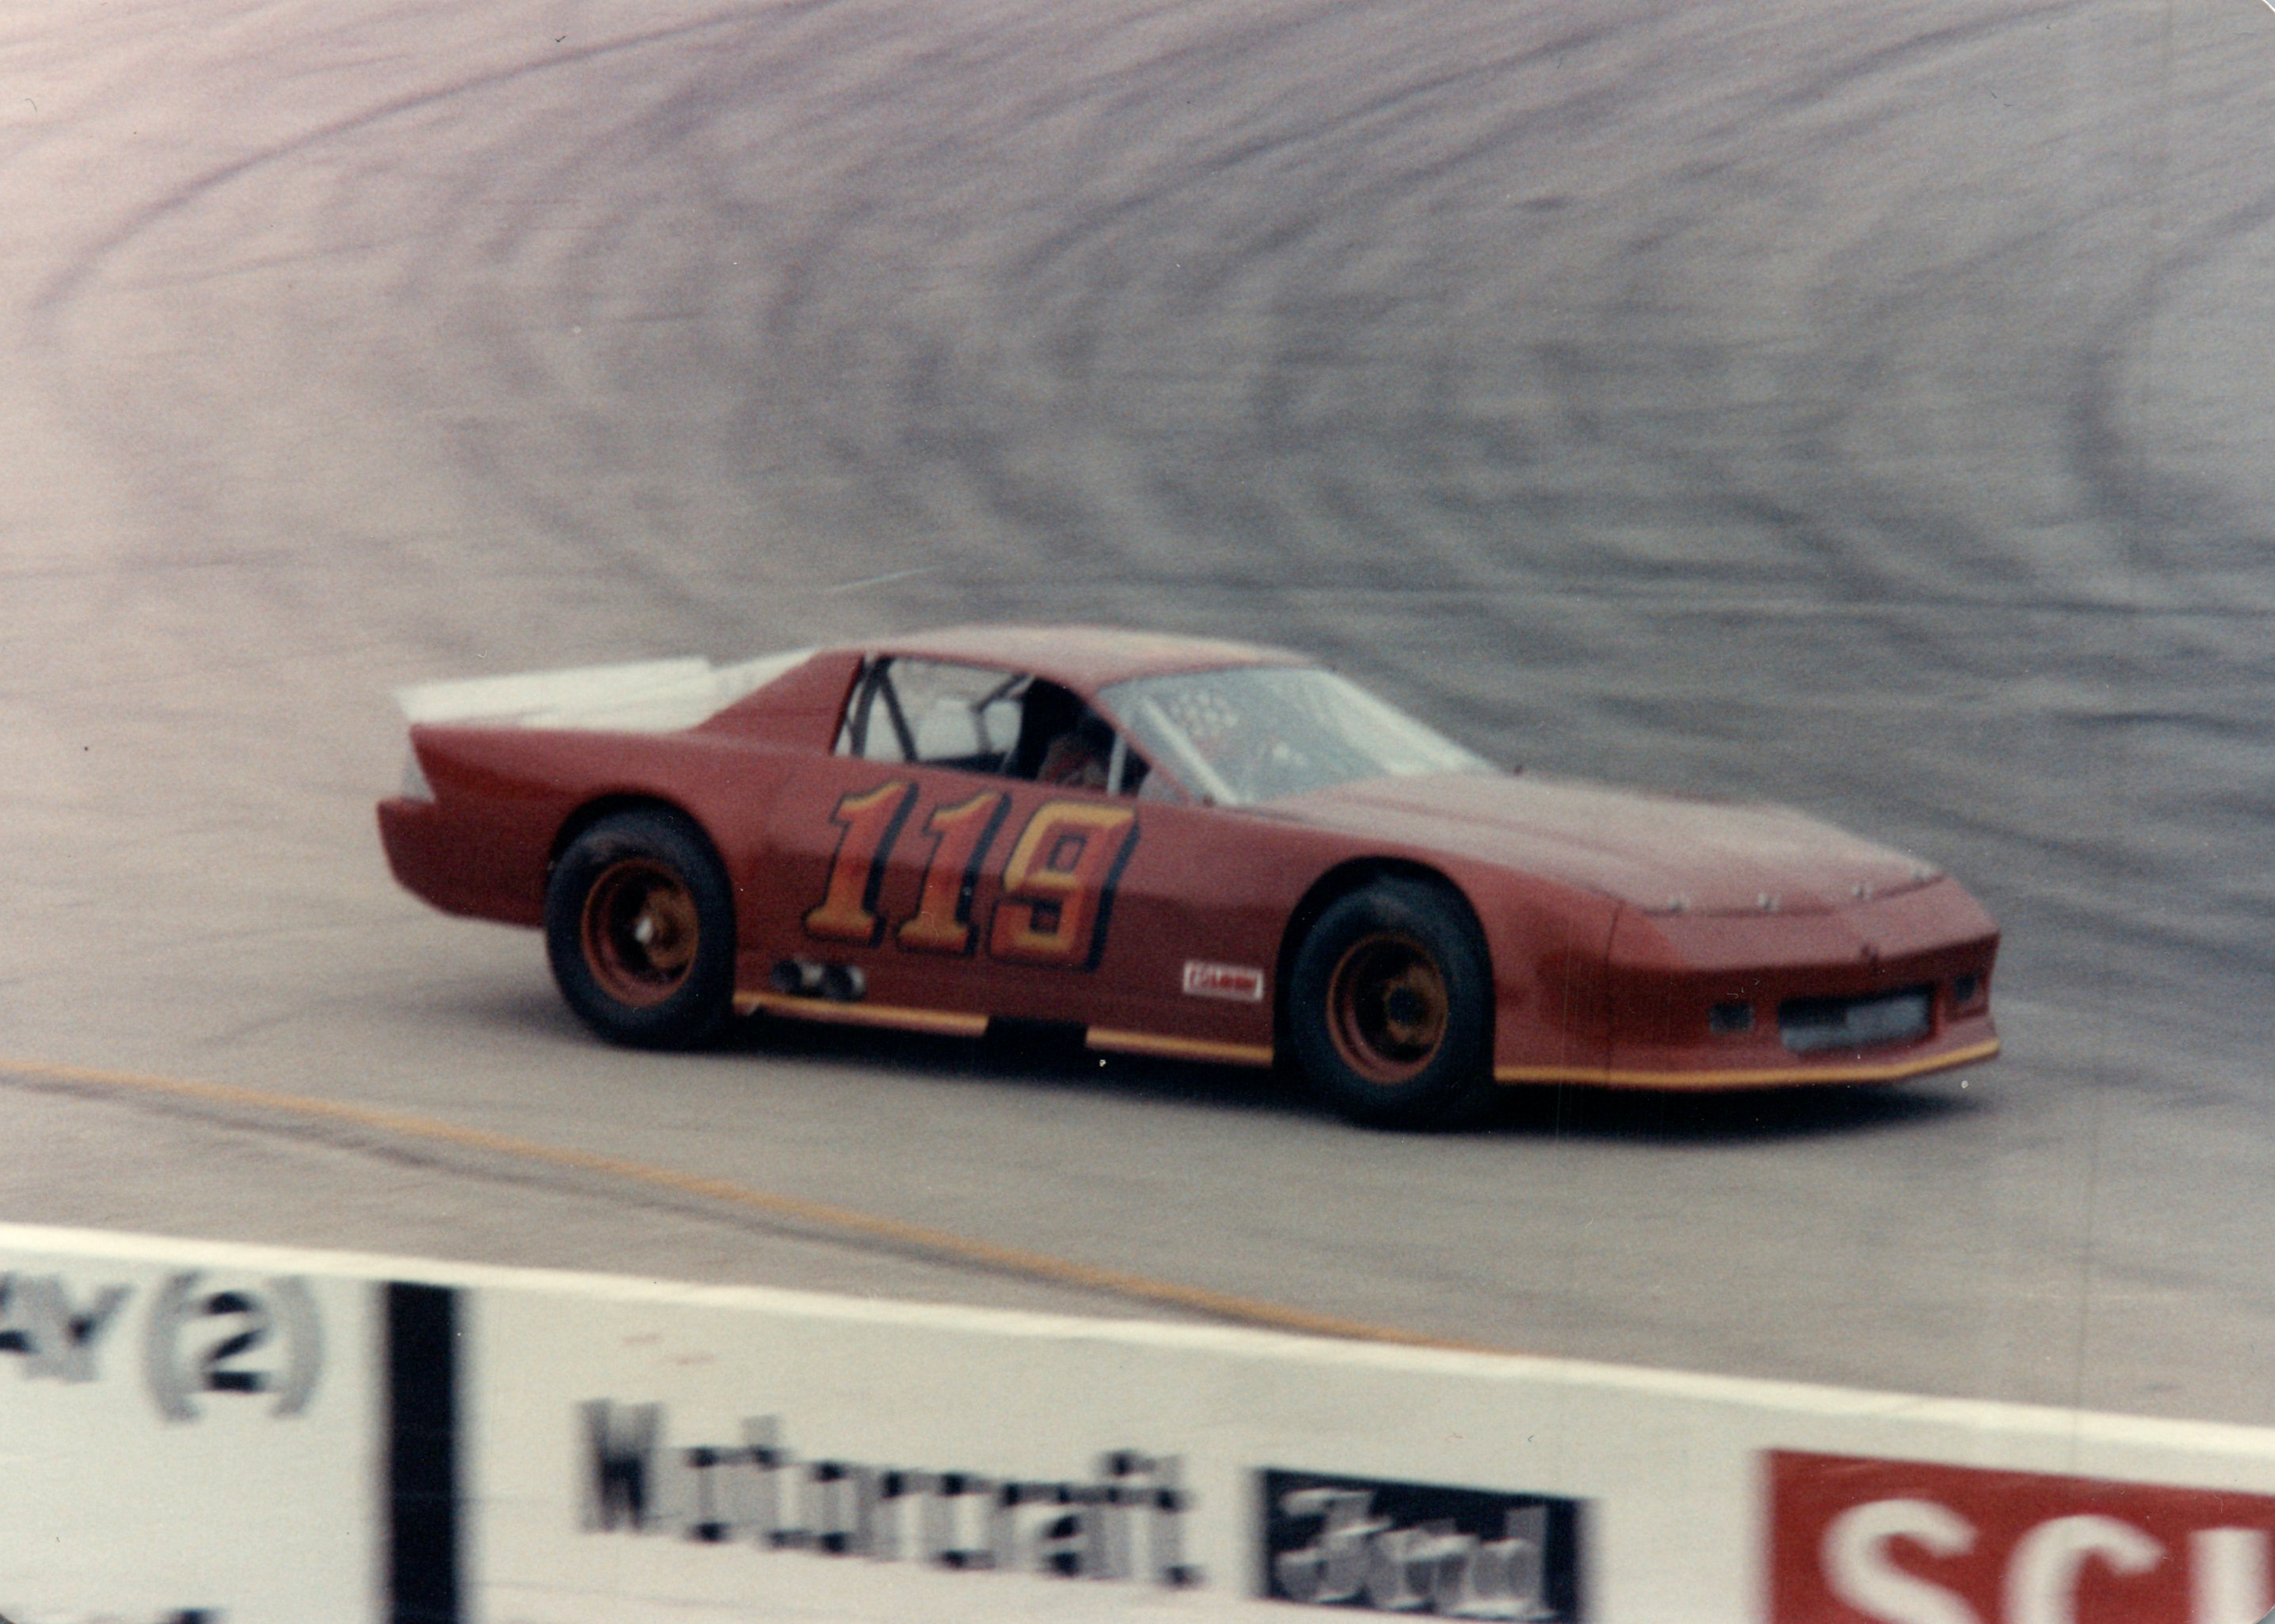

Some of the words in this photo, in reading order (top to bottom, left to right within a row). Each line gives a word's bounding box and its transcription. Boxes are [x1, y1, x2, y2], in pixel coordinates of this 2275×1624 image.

[802, 781, 1140, 972] 119
[141, 1268, 323, 1423] (2)
[577, 1398, 1203, 1589] Motorcraft
[1275, 1486, 1558, 1621] Ford
